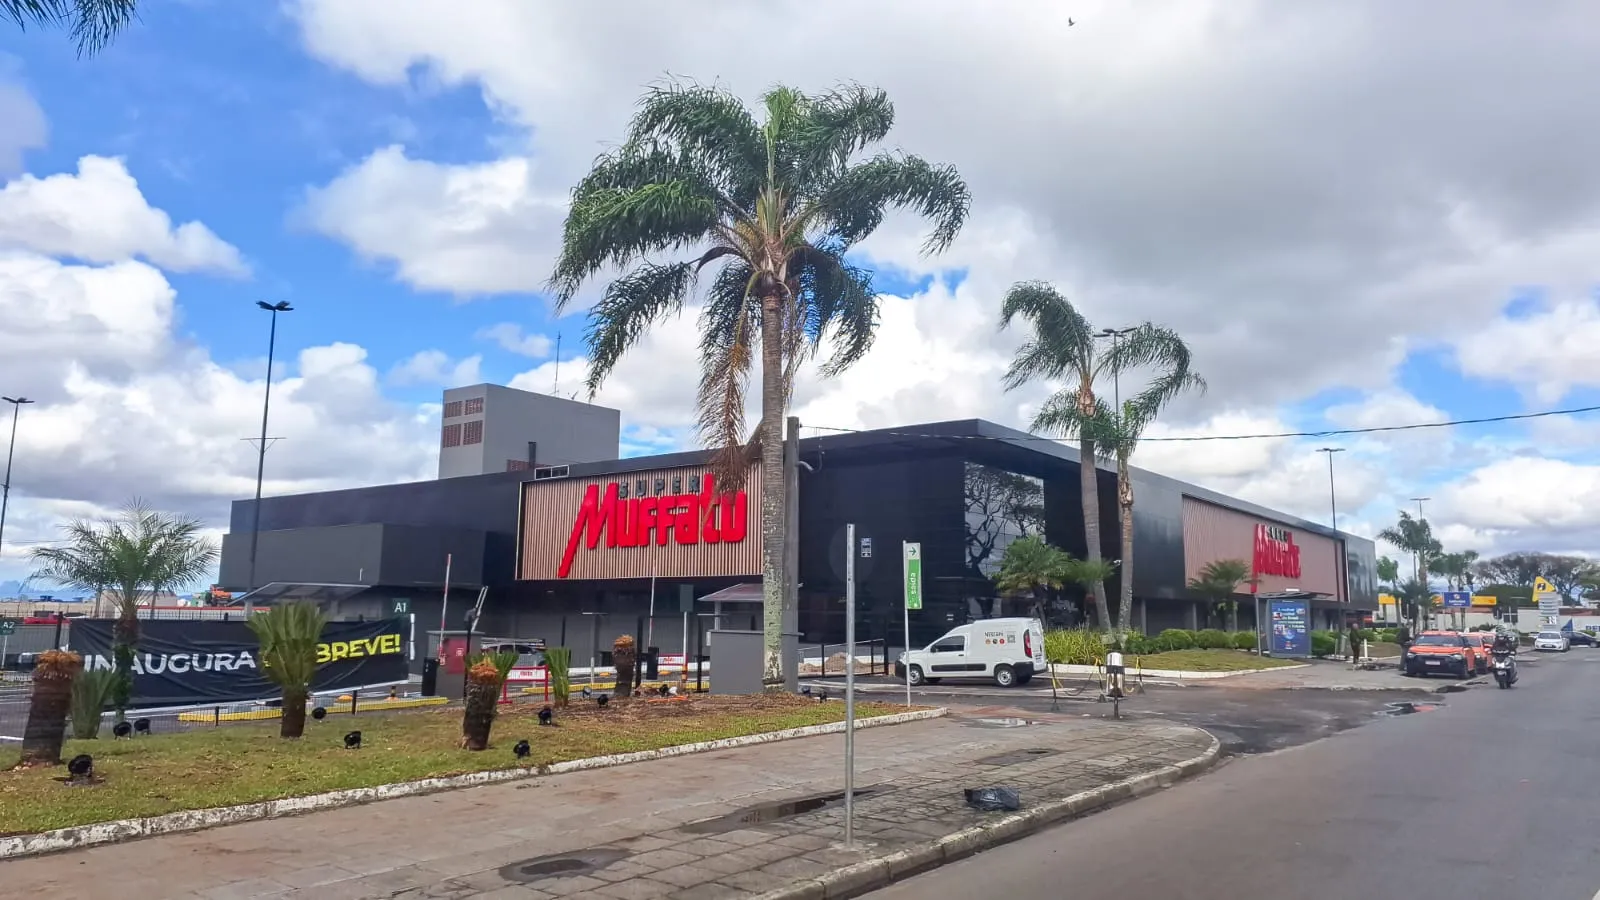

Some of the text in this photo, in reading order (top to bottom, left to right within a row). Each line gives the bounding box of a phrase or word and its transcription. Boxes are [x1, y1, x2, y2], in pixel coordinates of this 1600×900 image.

[618, 475, 700, 498] SUPER
[394, 602, 407, 613] A1
[3, 621, 15, 629] A2
[84, 650, 256, 675] INAUGURA
[316, 633, 401, 663] BREVE!
